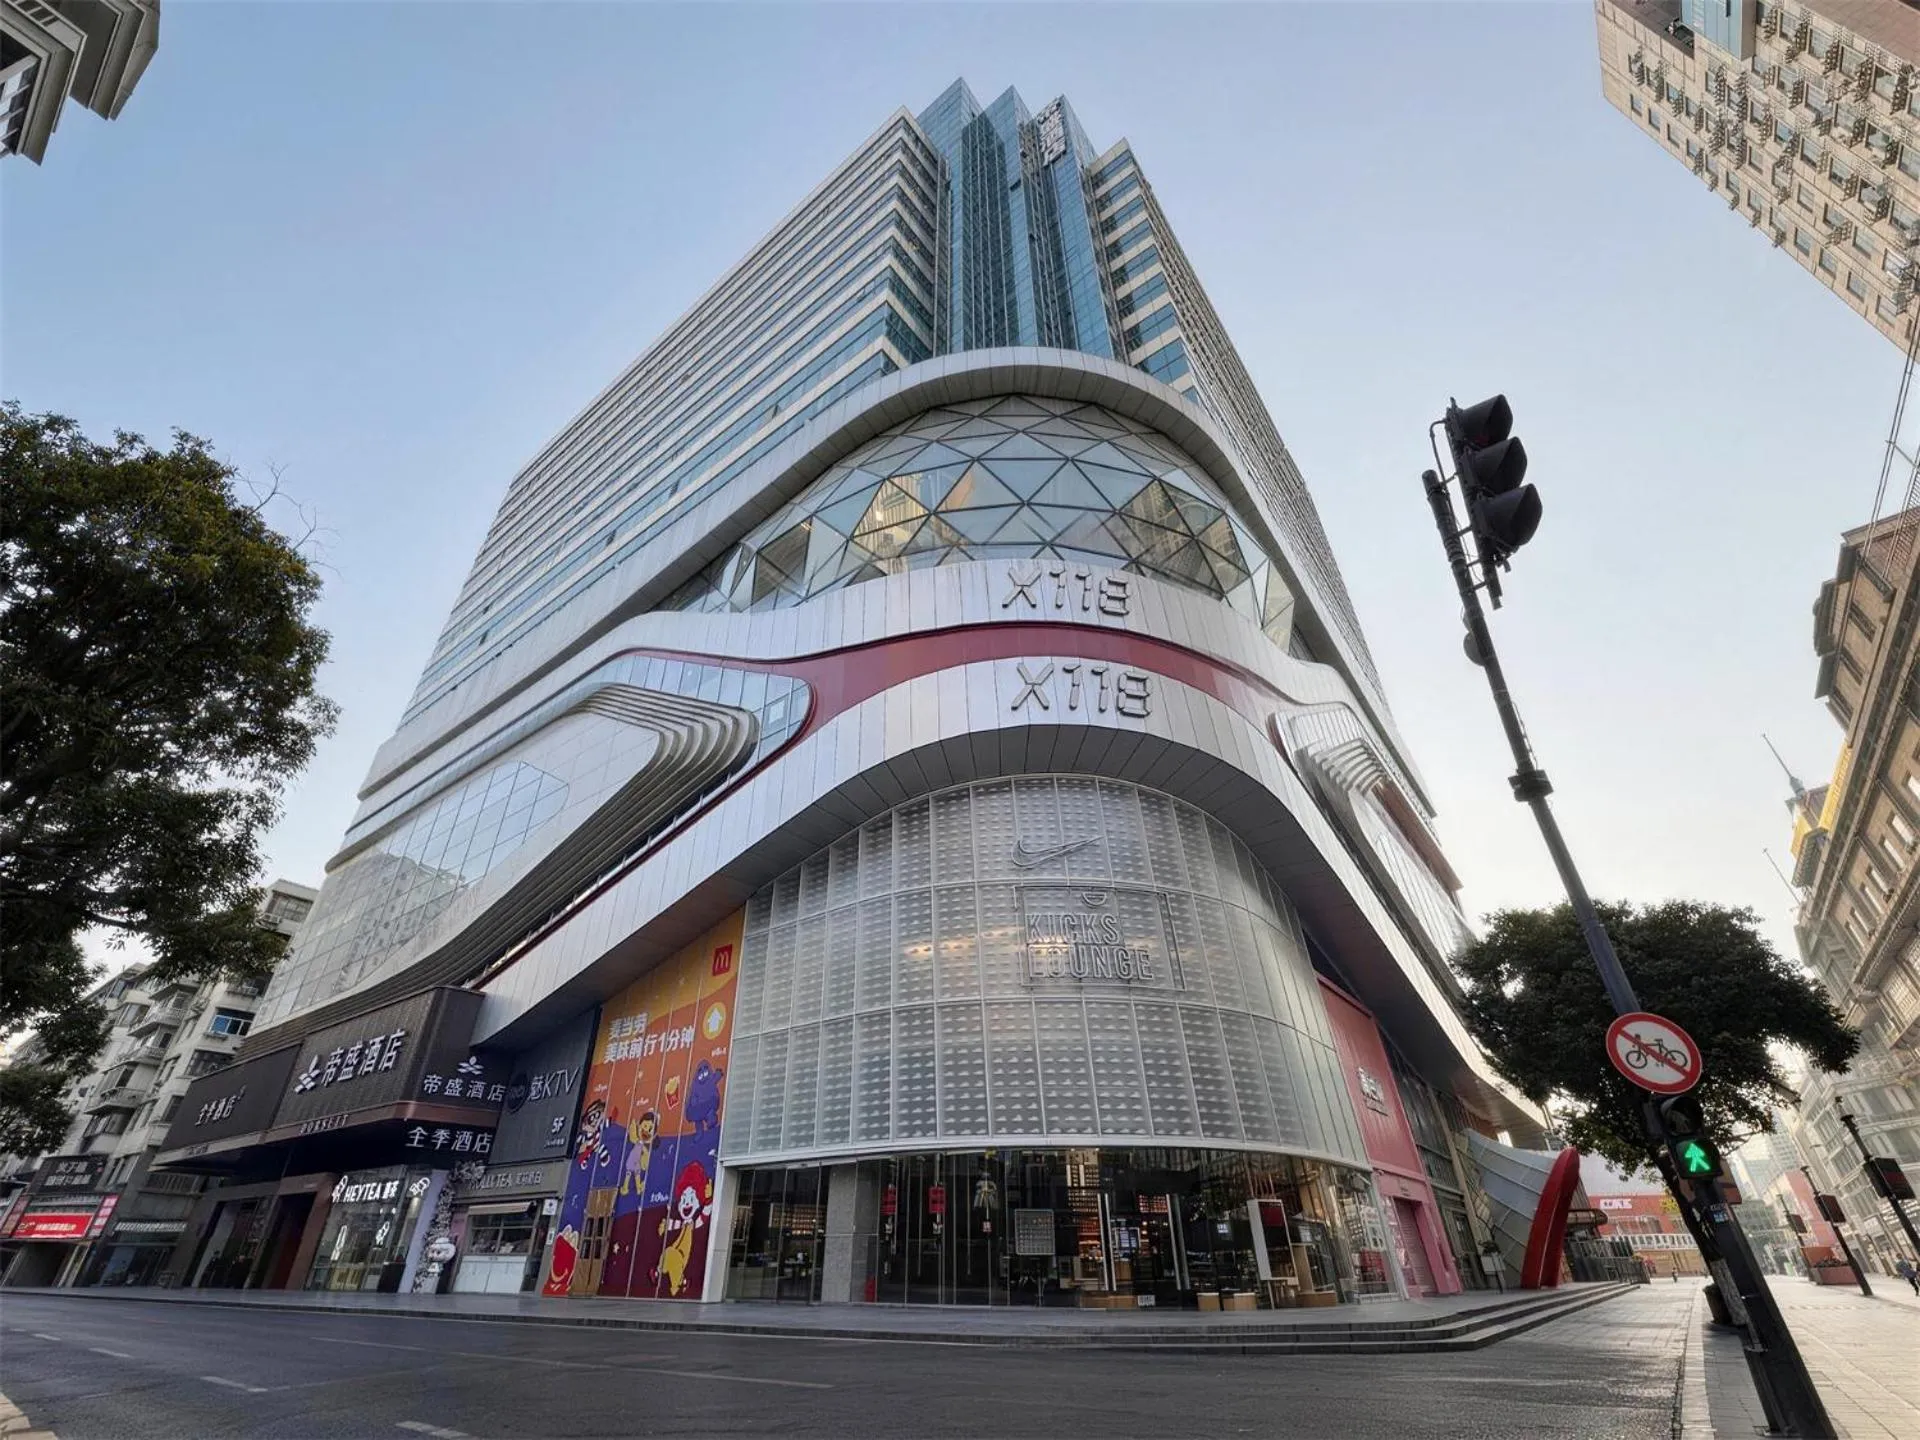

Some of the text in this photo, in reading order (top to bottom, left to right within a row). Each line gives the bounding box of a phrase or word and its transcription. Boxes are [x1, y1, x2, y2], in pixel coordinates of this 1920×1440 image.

[1002, 563, 1130, 616] X118
[1011, 662, 1151, 718] X118
[1026, 913, 1121, 944] KICKS
[1029, 944, 1154, 979] LOUNGE
[609, 1012, 648, 1039] 麦当劳
[321, 1028, 405, 1087] 帝盛酒店
[423, 1073, 506, 1101] 帝盛酒店
[195, 1094, 236, 1126] 全季酒店
[551, 1116, 565, 1133] 5F
[405, 1126, 493, 1153] 全季酒店
[343, 1181, 381, 1202] HEYTEA
